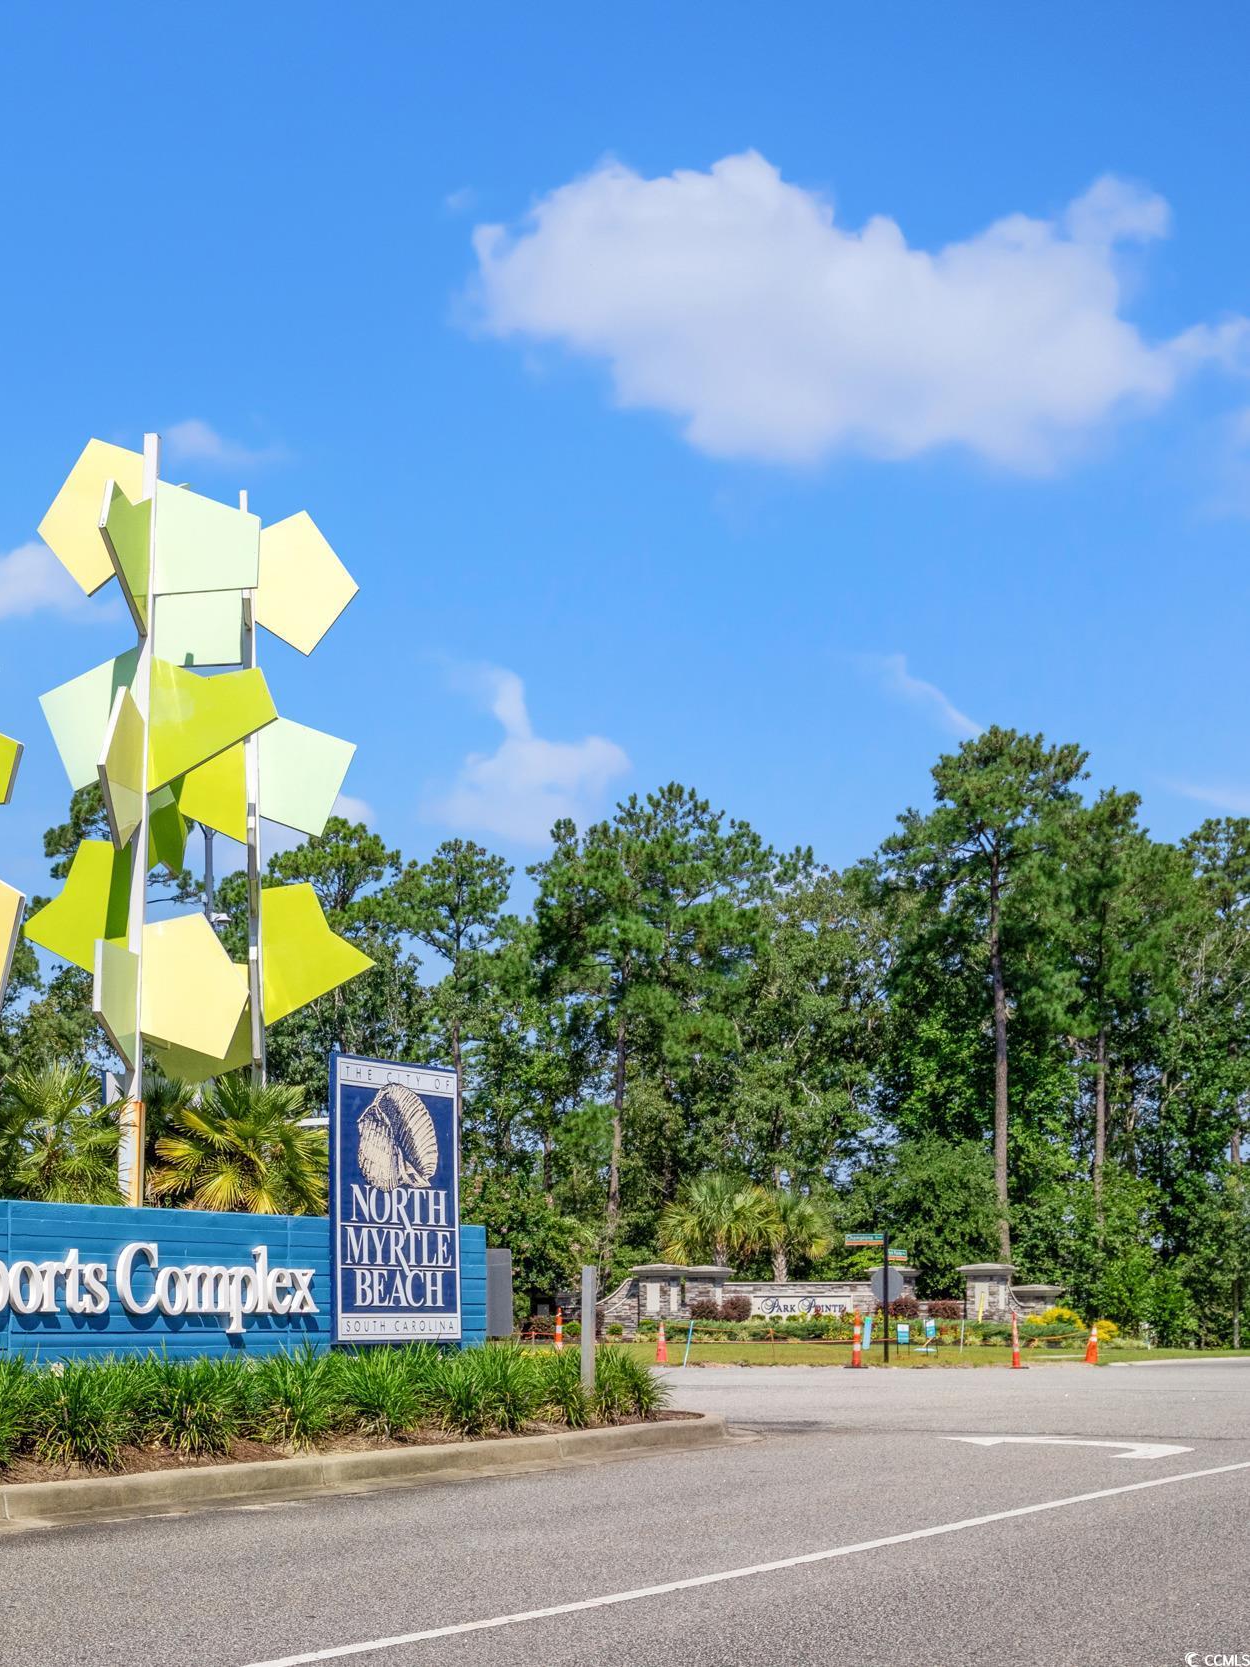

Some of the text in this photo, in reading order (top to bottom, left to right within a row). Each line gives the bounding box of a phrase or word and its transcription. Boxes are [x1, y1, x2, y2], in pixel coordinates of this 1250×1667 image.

[345, 1066, 450, 1090] THE CITY OF
[350, 1184, 448, 1228] NORTH
[345, 1226, 452, 1270] MYRTLE
[116, 1242, 320, 1333] Complex
[353, 1269, 445, 1307] BEACH
[761, 1297, 796, 1314] PARK
[346, 1321, 455, 1332] SOUTH CAROLINA
